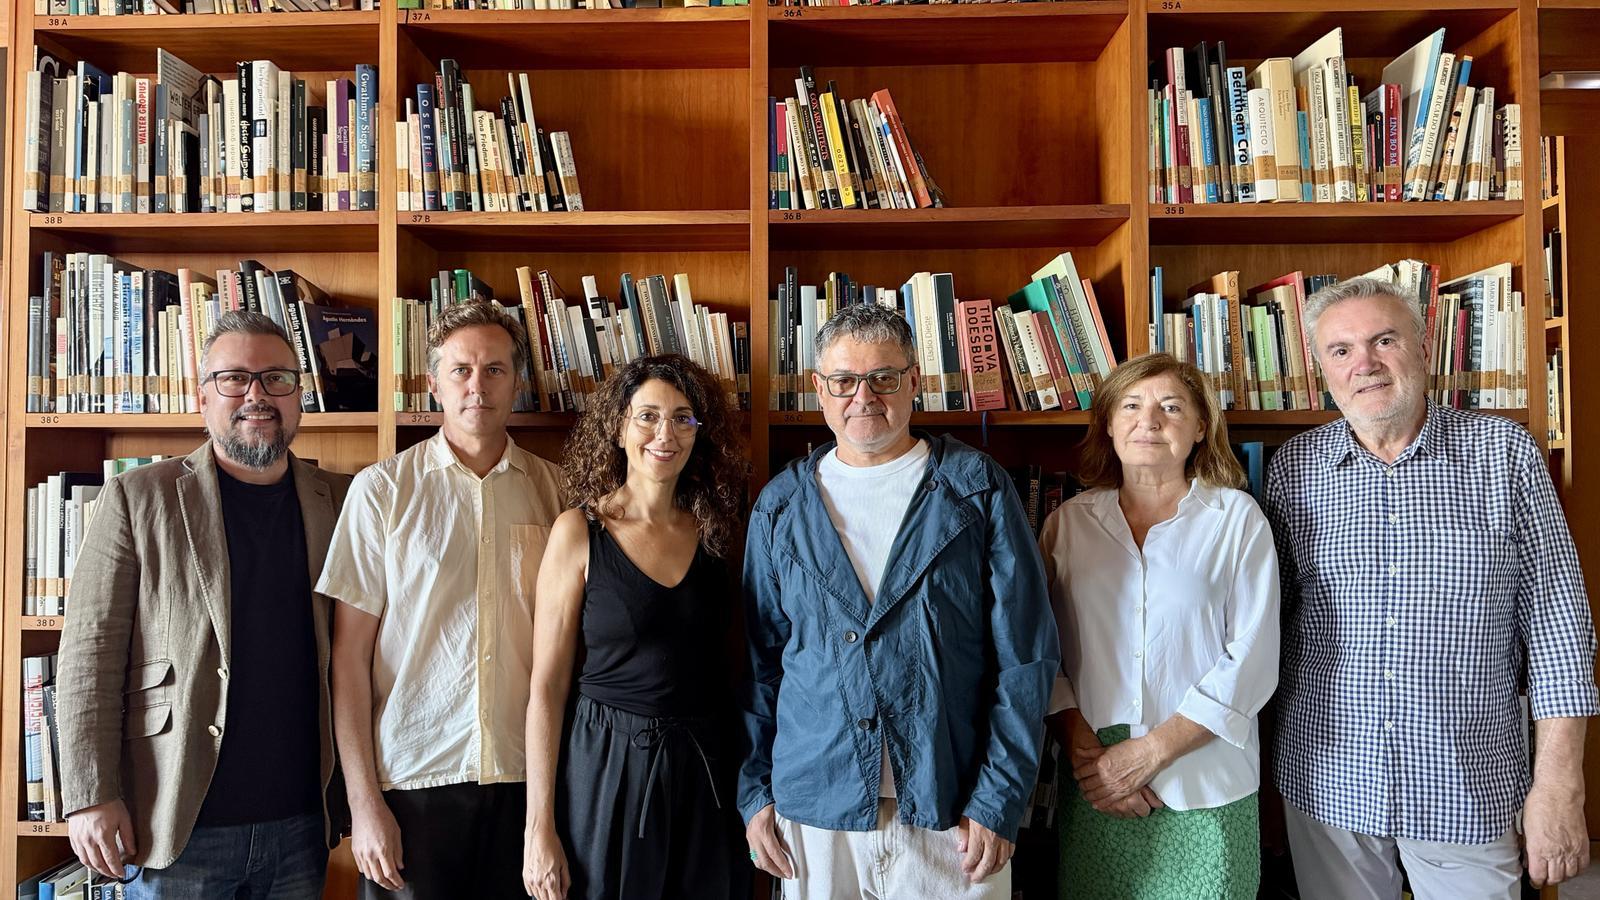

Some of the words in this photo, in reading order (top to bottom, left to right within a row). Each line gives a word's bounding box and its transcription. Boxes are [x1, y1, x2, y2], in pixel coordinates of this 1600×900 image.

[359, 73, 369, 122] Gwathmey
[810, 93, 819, 110] COX
[1232, 70, 1246, 136] Benthem
[1430, 95, 1443, 130] RICARDO
[420, 90, 431, 140] JOSEF
[1258, 97, 1268, 145] ARQUITECTO
[1389, 117, 1397, 136] LINA
[240, 121, 250, 144] Hector
[360, 124, 370, 152] Siegel
[813, 111, 829, 160] ARCHITECTS
[1389, 139, 1397, 151] BO
[1425, 132, 1436, 159] BOFILL
[480, 134, 489, 167] Friedman
[796, 144, 804, 167] CORTONA
[1318, 144, 1326, 163] Ottavio
[360, 159, 370, 192] Hos
[836, 148, 851, 196] CRALZOO
[1238, 139, 1250, 198] Croel
[246, 275, 256, 309] RICHARD
[1487, 280, 1497, 304] MARIO
[924, 316, 934, 338] Dieste
[980, 306, 993, 342] THEO
[1230, 294, 1238, 343] CASTELLANA
[1487, 304, 1496, 327] BOTTA
[288, 303, 297, 330] agustín
[295, 330, 307, 368] hernández
[967, 307, 984, 374] DOESBUR
[1069, 308, 1095, 366] DOMENECH
[986, 353, 997, 371] VA
[40, 416, 51, 424] 38
[53, 416, 59, 424] C
[412, 415, 422, 423] 37
[424, 415, 431, 423] C
